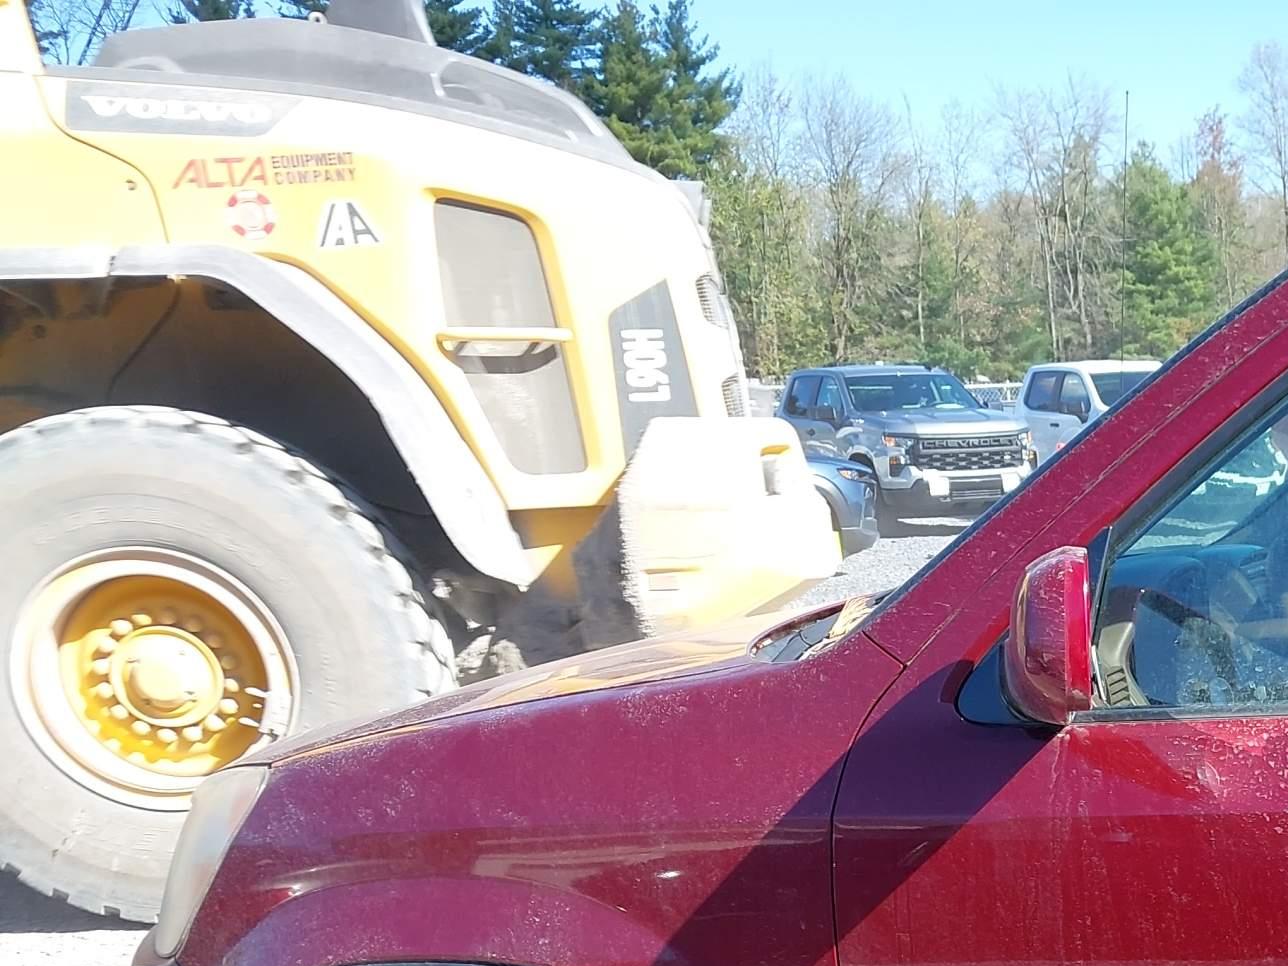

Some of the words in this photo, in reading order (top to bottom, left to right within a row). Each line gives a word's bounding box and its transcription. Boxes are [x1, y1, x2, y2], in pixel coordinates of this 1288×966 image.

[80, 95, 272, 123] VOLVO
[172, 156, 270, 190] ALTA
[271, 152, 354, 170] EQUIPMENT
[273, 168, 357, 186] COMPANY
[620, 328, 672, 402] L90H
